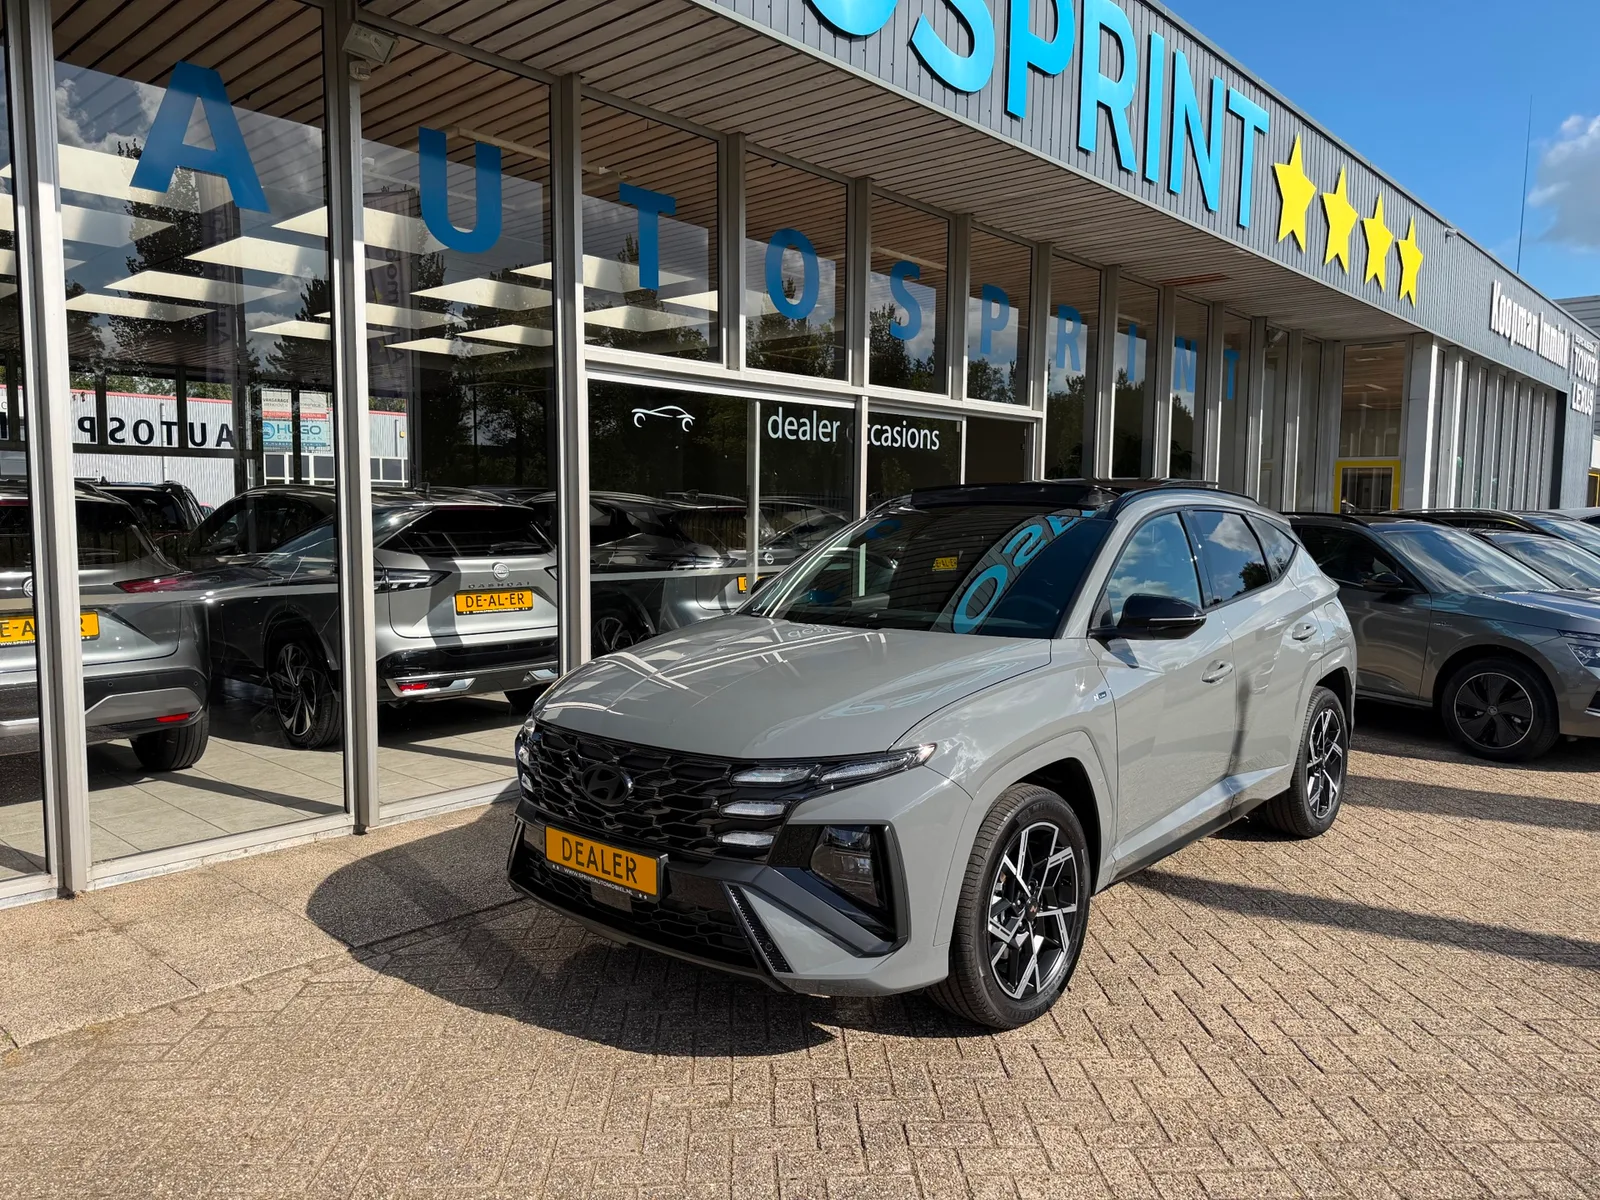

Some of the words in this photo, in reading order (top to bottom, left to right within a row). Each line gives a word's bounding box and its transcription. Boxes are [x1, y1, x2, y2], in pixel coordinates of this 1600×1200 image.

[811, 0, 1269, 229] SPRINT
[1491, 280, 1538, 352] Koopman
[1574, 346, 1598, 385] TOYOTA
[1572, 381, 1593, 416] LEXUS
[767, 406, 840, 442] dealer
[847, 420, 940, 450] casions
[562, 837, 637, 884] DEALER
